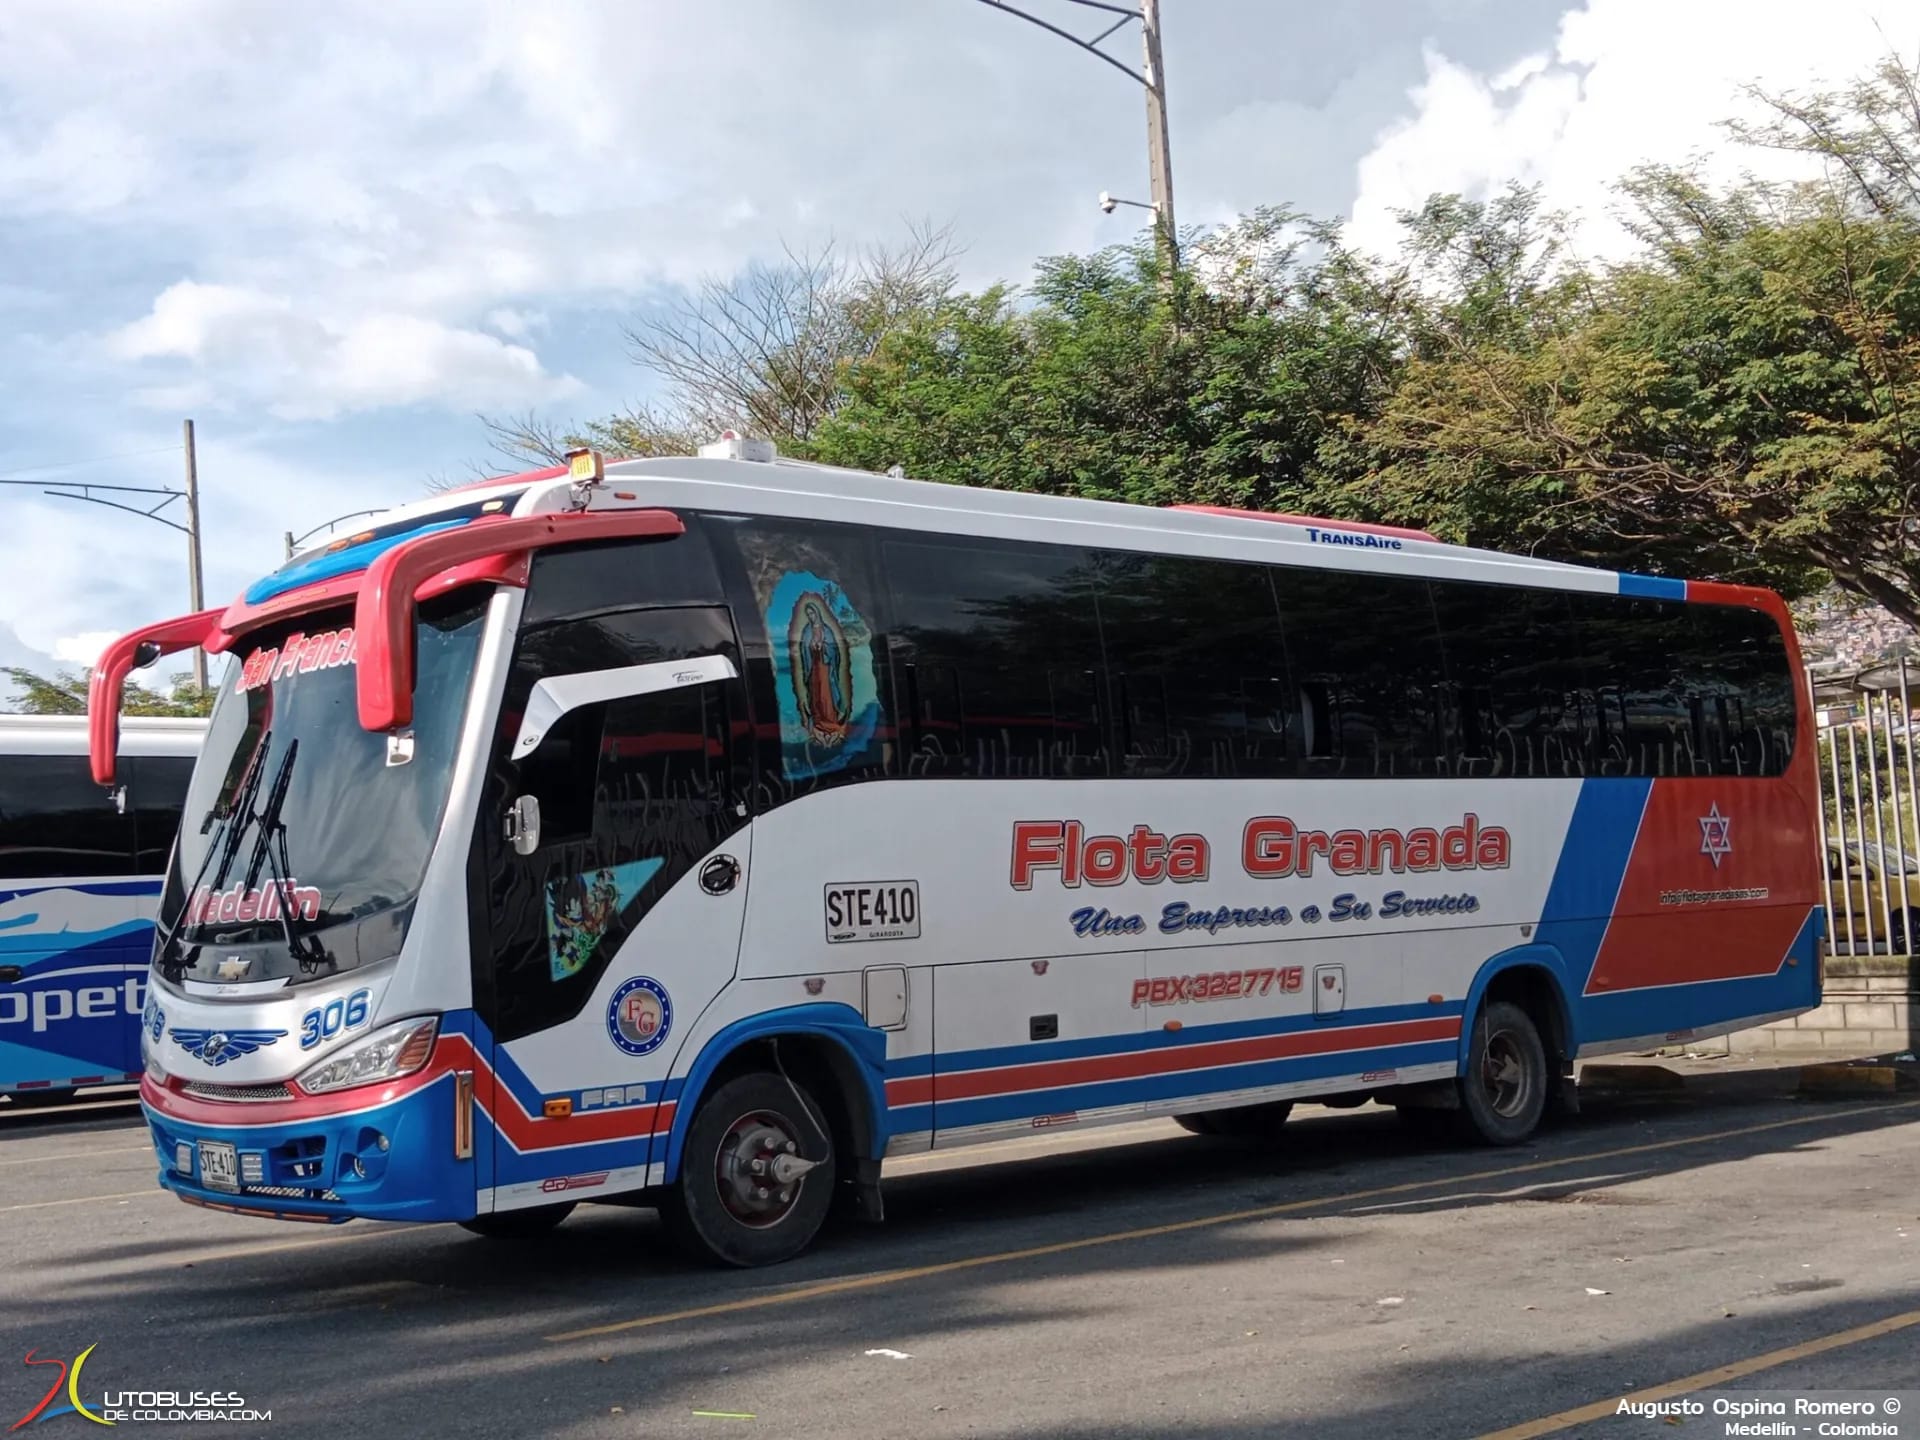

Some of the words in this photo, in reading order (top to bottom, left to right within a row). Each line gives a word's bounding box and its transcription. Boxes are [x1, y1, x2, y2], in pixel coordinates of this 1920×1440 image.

[235, 646, 279, 695] San
[1010, 819, 1209, 891] Flota
[1241, 813, 1511, 879] Granada
[828, 887, 915, 927] STE410
[1069, 906, 1147, 937] Una
[1158, 901, 1292, 935] Empresa
[1299, 904, 1322, 924] a
[1327, 893, 1373, 922] Su
[1378, 890, 1481, 918] Servicio
[1131, 966, 1304, 1009] PBX:3227715
[300, 987, 374, 1051] 306
[625, 997, 657, 1036] FG
